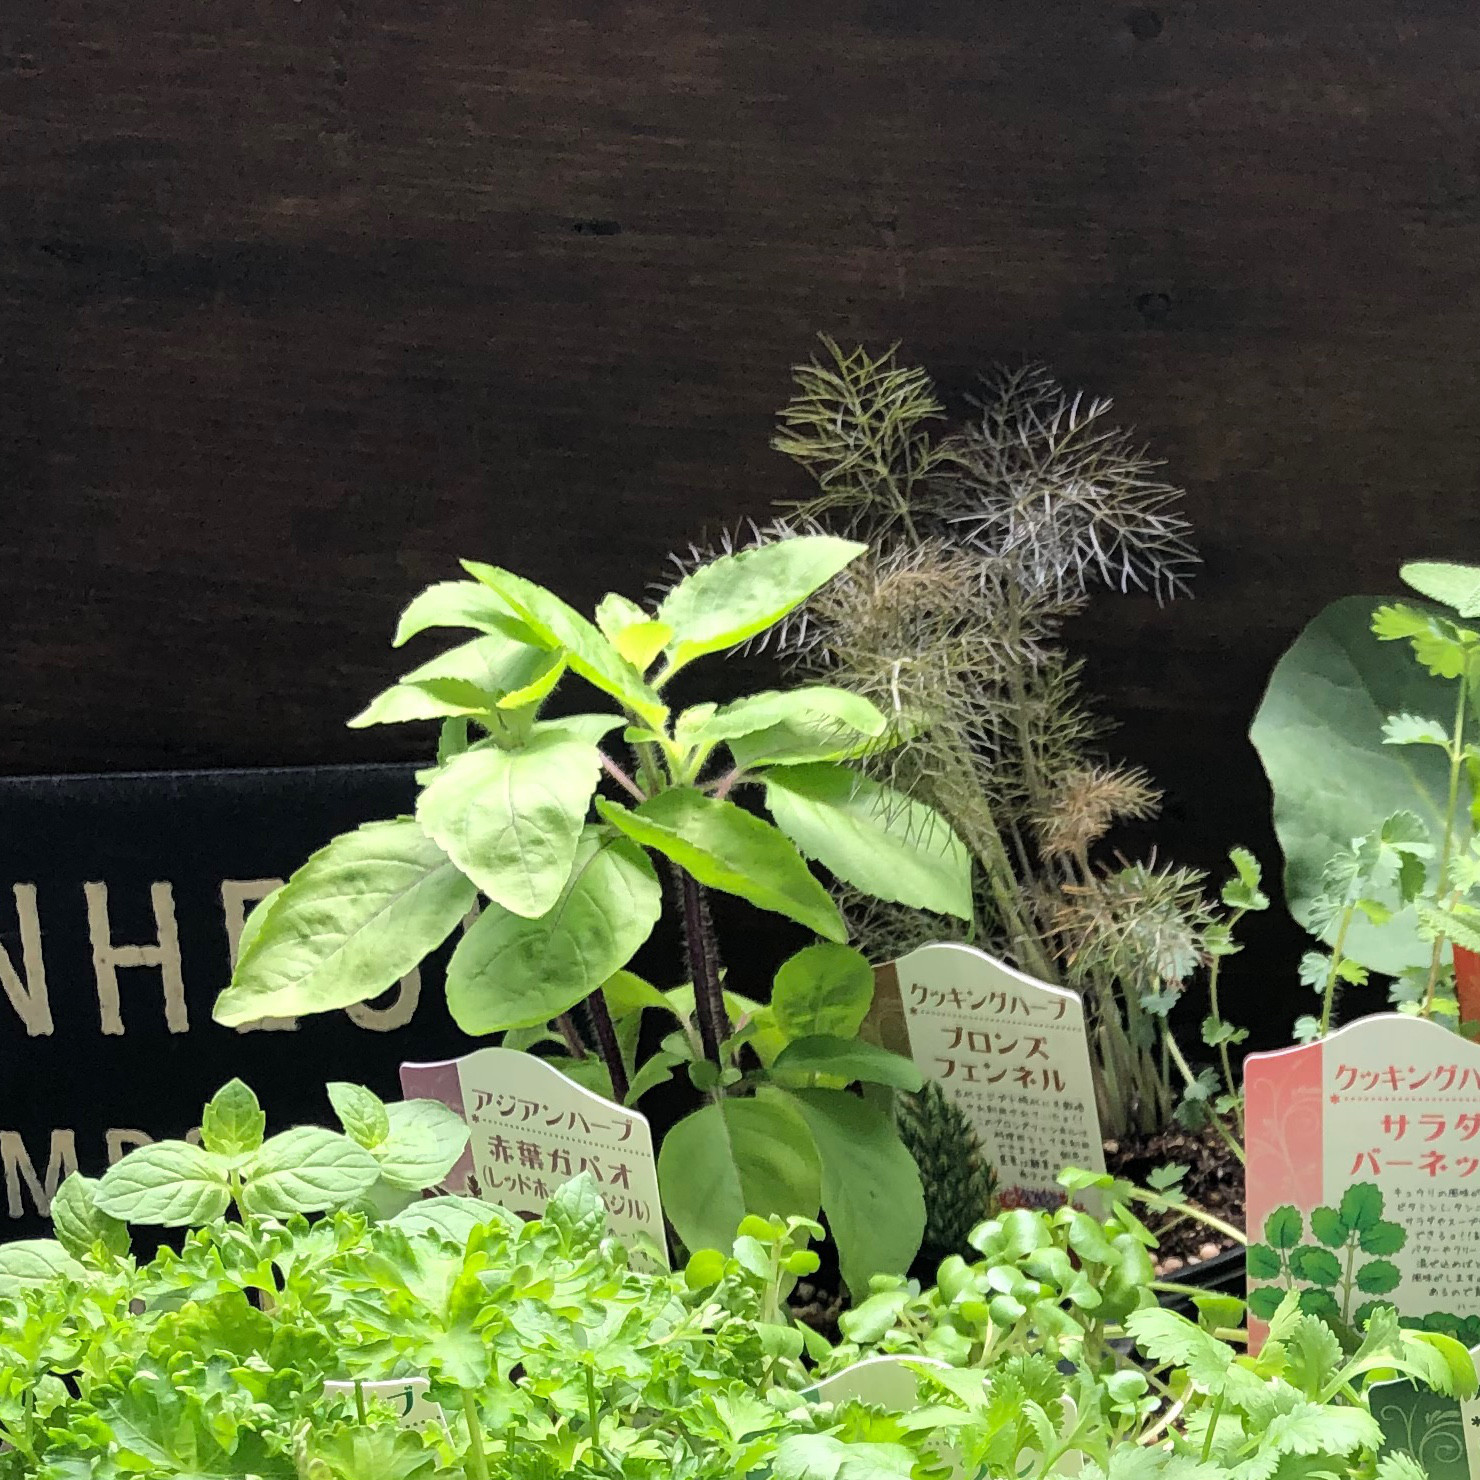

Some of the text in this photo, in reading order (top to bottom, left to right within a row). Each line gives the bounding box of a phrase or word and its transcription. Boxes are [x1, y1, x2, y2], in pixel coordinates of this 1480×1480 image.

[911, 983, 1067, 1021] クッキングハーブ
[941, 1025, 1050, 1060] ブロンズ
[934, 1057, 1067, 1093] フェンネル
[471, 1088, 633, 1142] アジアンハーブ
[487, 1134, 632, 1190] 赤葉ガパオ
